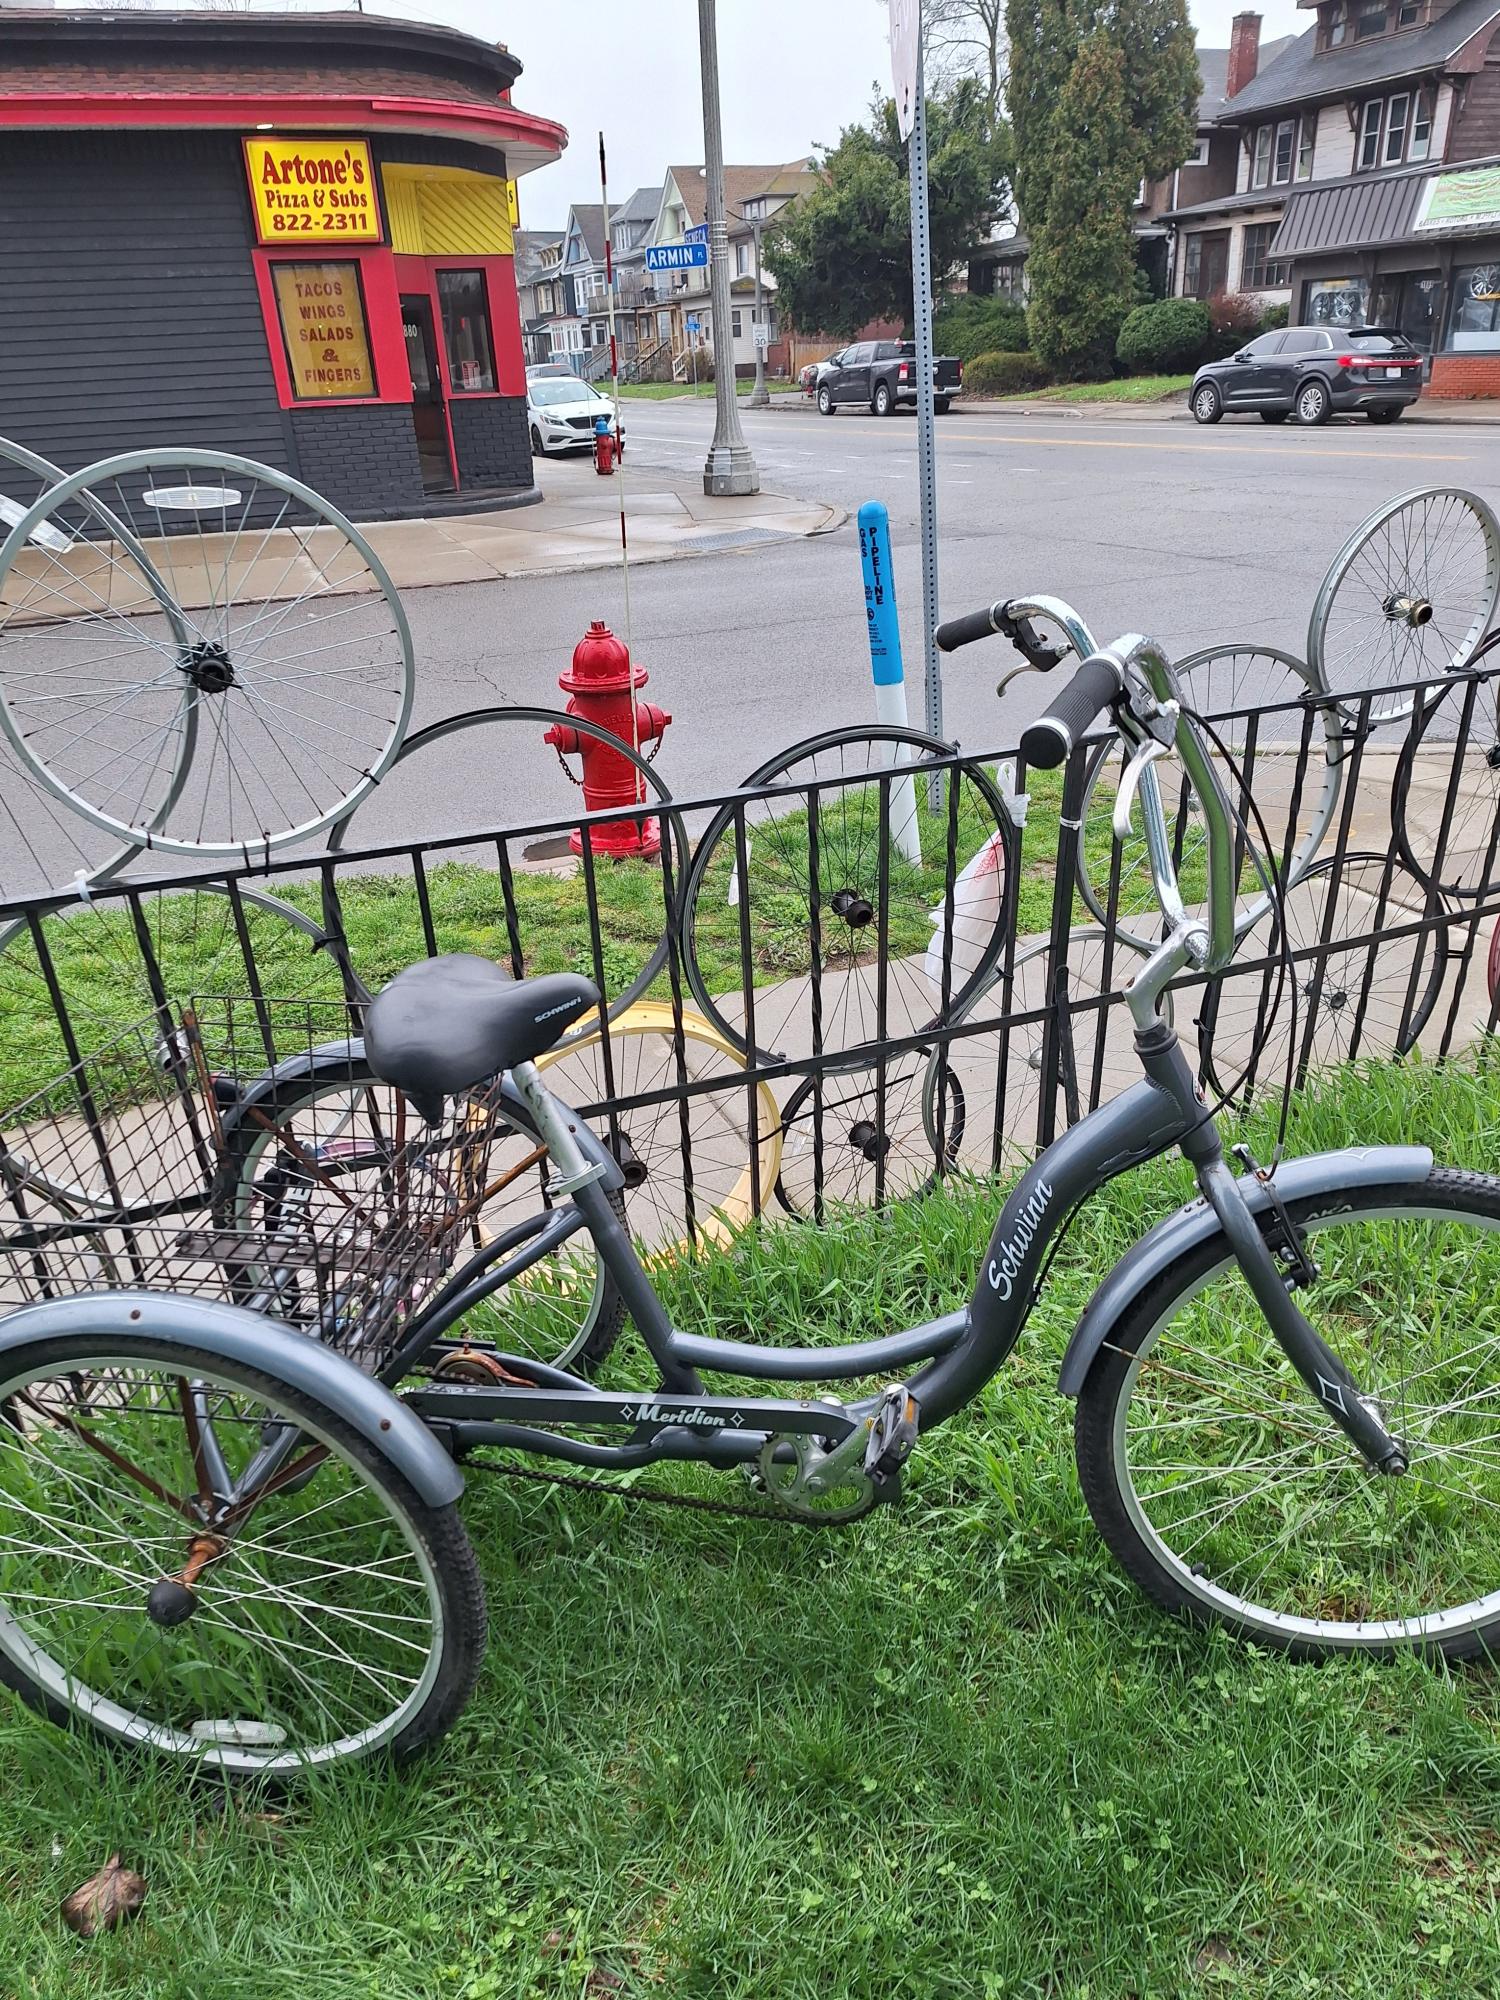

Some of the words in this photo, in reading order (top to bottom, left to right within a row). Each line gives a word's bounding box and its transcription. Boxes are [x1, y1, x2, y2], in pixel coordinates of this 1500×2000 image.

[262, 149, 365, 185] Artone's
[265, 189, 310, 208] Pizza
[313, 189, 325, 208] &
[329, 189, 368, 208] Subs
[273, 213, 368, 231] 822-2311
[649, 247, 694, 267] ARMIN
[295, 281, 343, 298] TACOS
[300, 304, 346, 320] WINGS
[300, 327, 354, 342] SALADS
[754, 337, 767, 346] 30
[322, 348, 339, 363] &
[305, 368, 361, 383] FINGERS
[859, 528, 868, 558] GAS
[869, 527, 884, 605] PIPELINE
[534, 996, 582, 1024] SCHWINN
[988, 1178, 1053, 1301] Schwinn
[635, 1403, 726, 1427] Meridian
